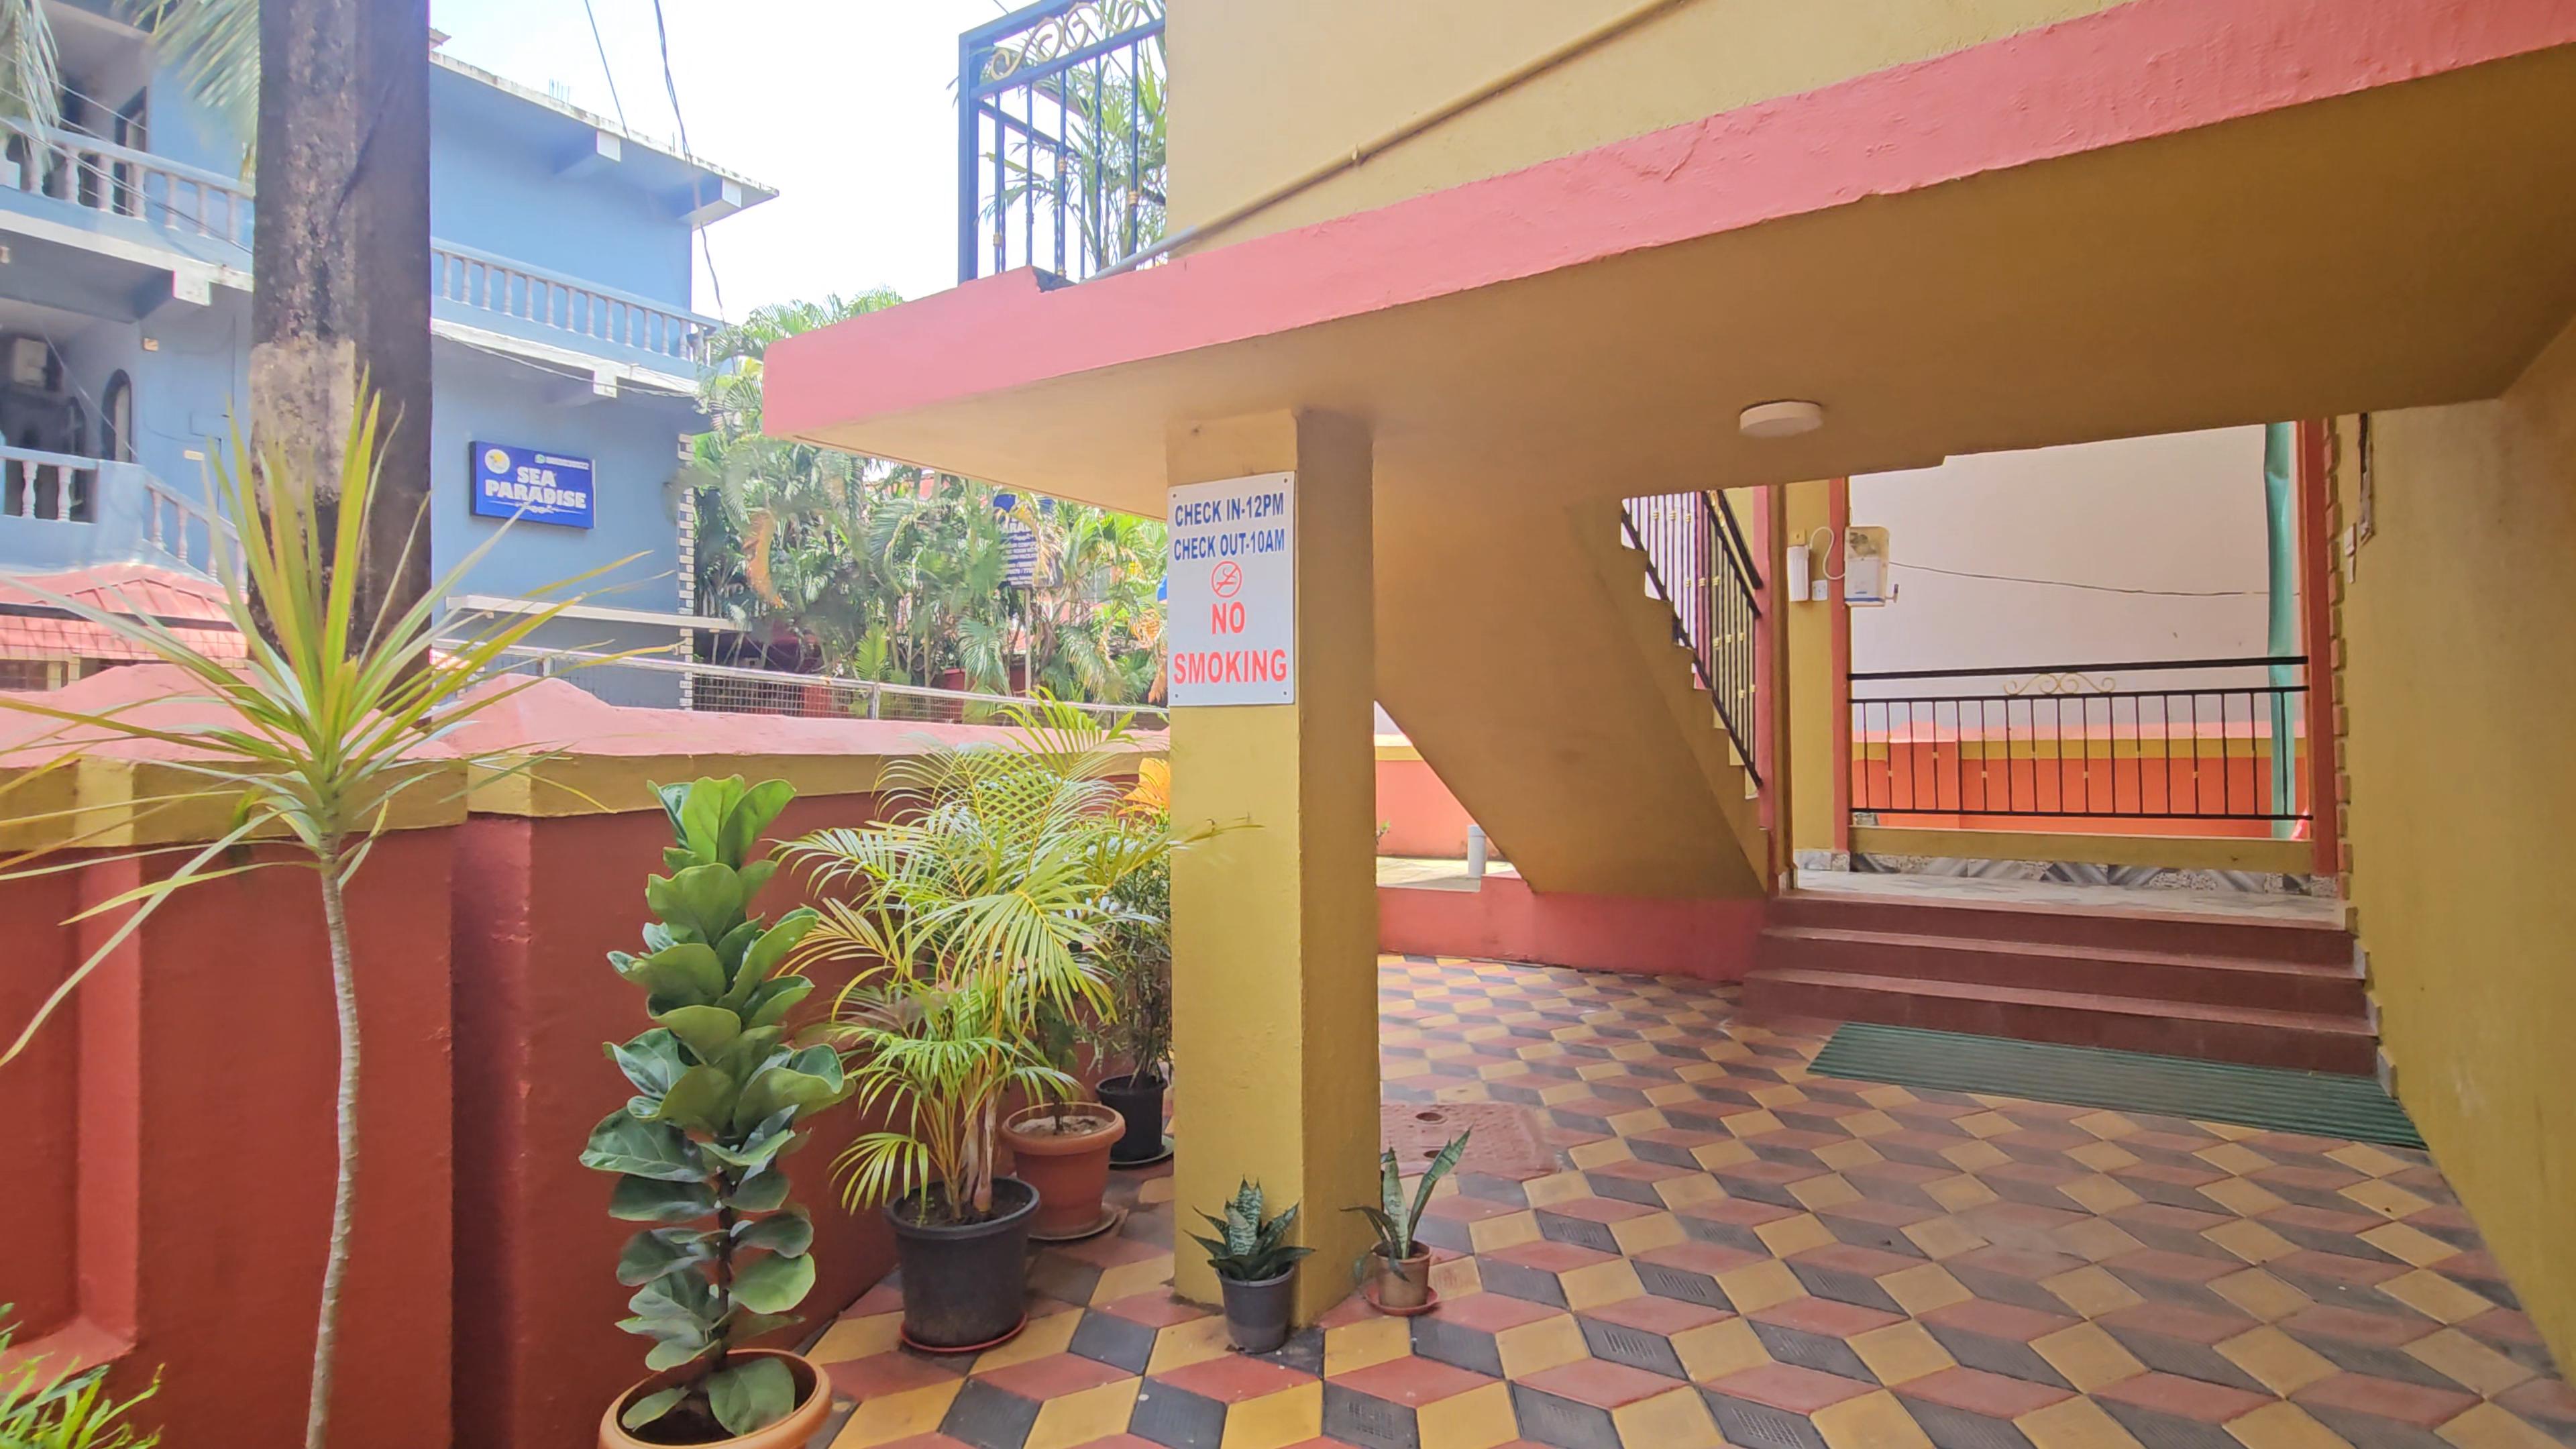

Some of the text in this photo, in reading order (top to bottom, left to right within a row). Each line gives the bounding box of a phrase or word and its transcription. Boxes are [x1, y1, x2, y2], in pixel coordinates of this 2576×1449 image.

[517, 466, 557, 487] SEA
[485, 479, 587, 509] PARADISE
[1175, 492, 1284, 527] CHECK IN-12PM
[1174, 528, 1285, 561] CHECK OUT-10AM
[1212, 601, 1246, 635] NO
[1174, 649, 1287, 684] SMOKING
